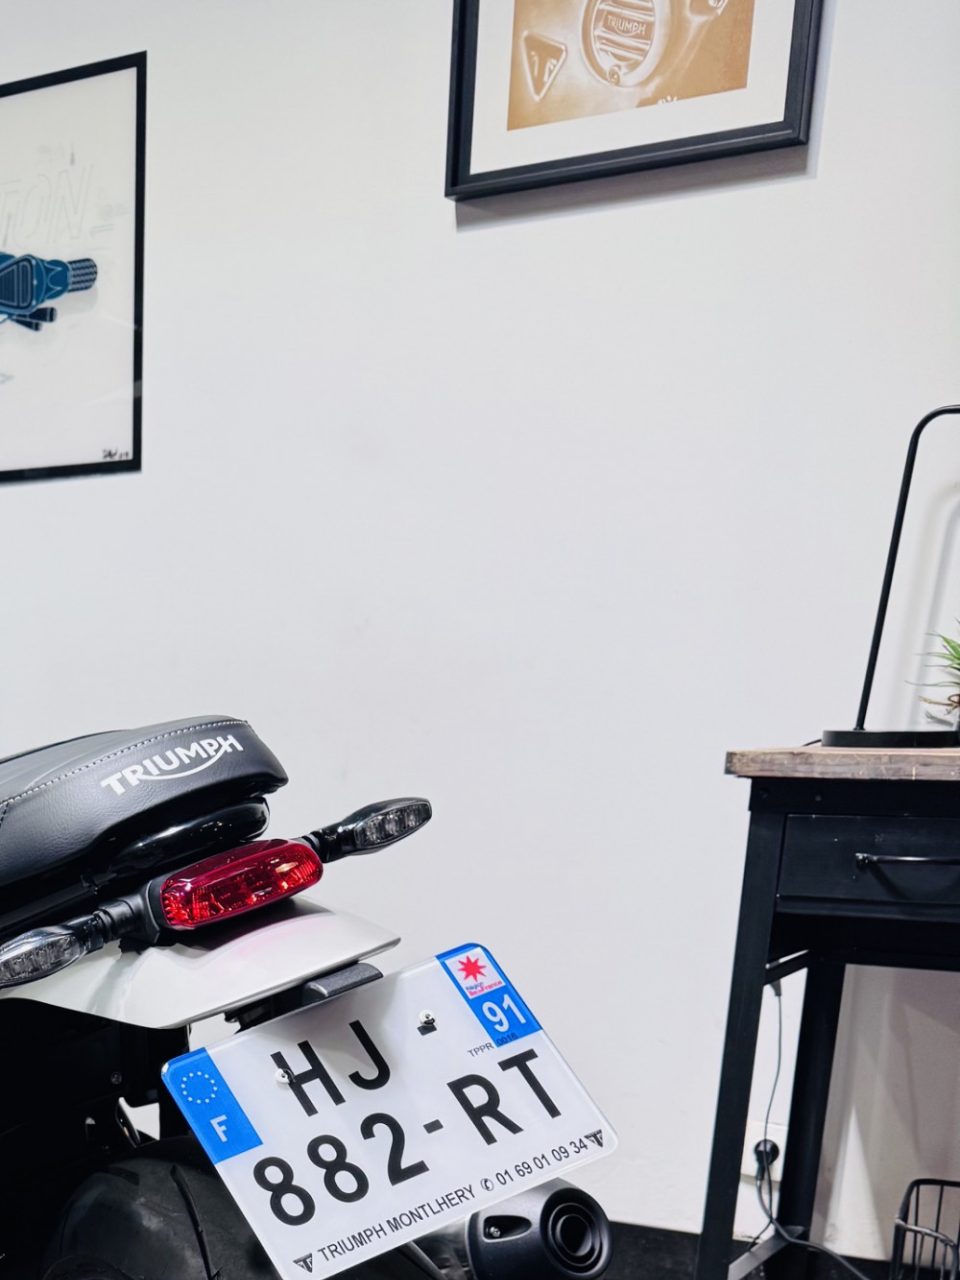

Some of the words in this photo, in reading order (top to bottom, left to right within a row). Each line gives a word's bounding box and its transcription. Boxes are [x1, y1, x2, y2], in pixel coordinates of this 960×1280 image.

[606, 14, 647, 37] TRIUMPH
[100, 734, 244, 797] TRIUMPH
[482, 994, 526, 1032] 91
[467, 1042, 495, 1058] TPPR
[210, 1114, 228, 1143] F
[253, 1048, 562, 1226] 882-RT
[317, 1226, 387, 1263] TRIUMPH
[388, 1184, 477, 1234] MONTLHERY
[495, 1168, 514, 1186] 01
[514, 1161, 533, 1178] 69
[533, 1153, 551, 1170] 01
[551, 1145, 570, 1162] 09
[569, 1138, 589, 1154] 34
